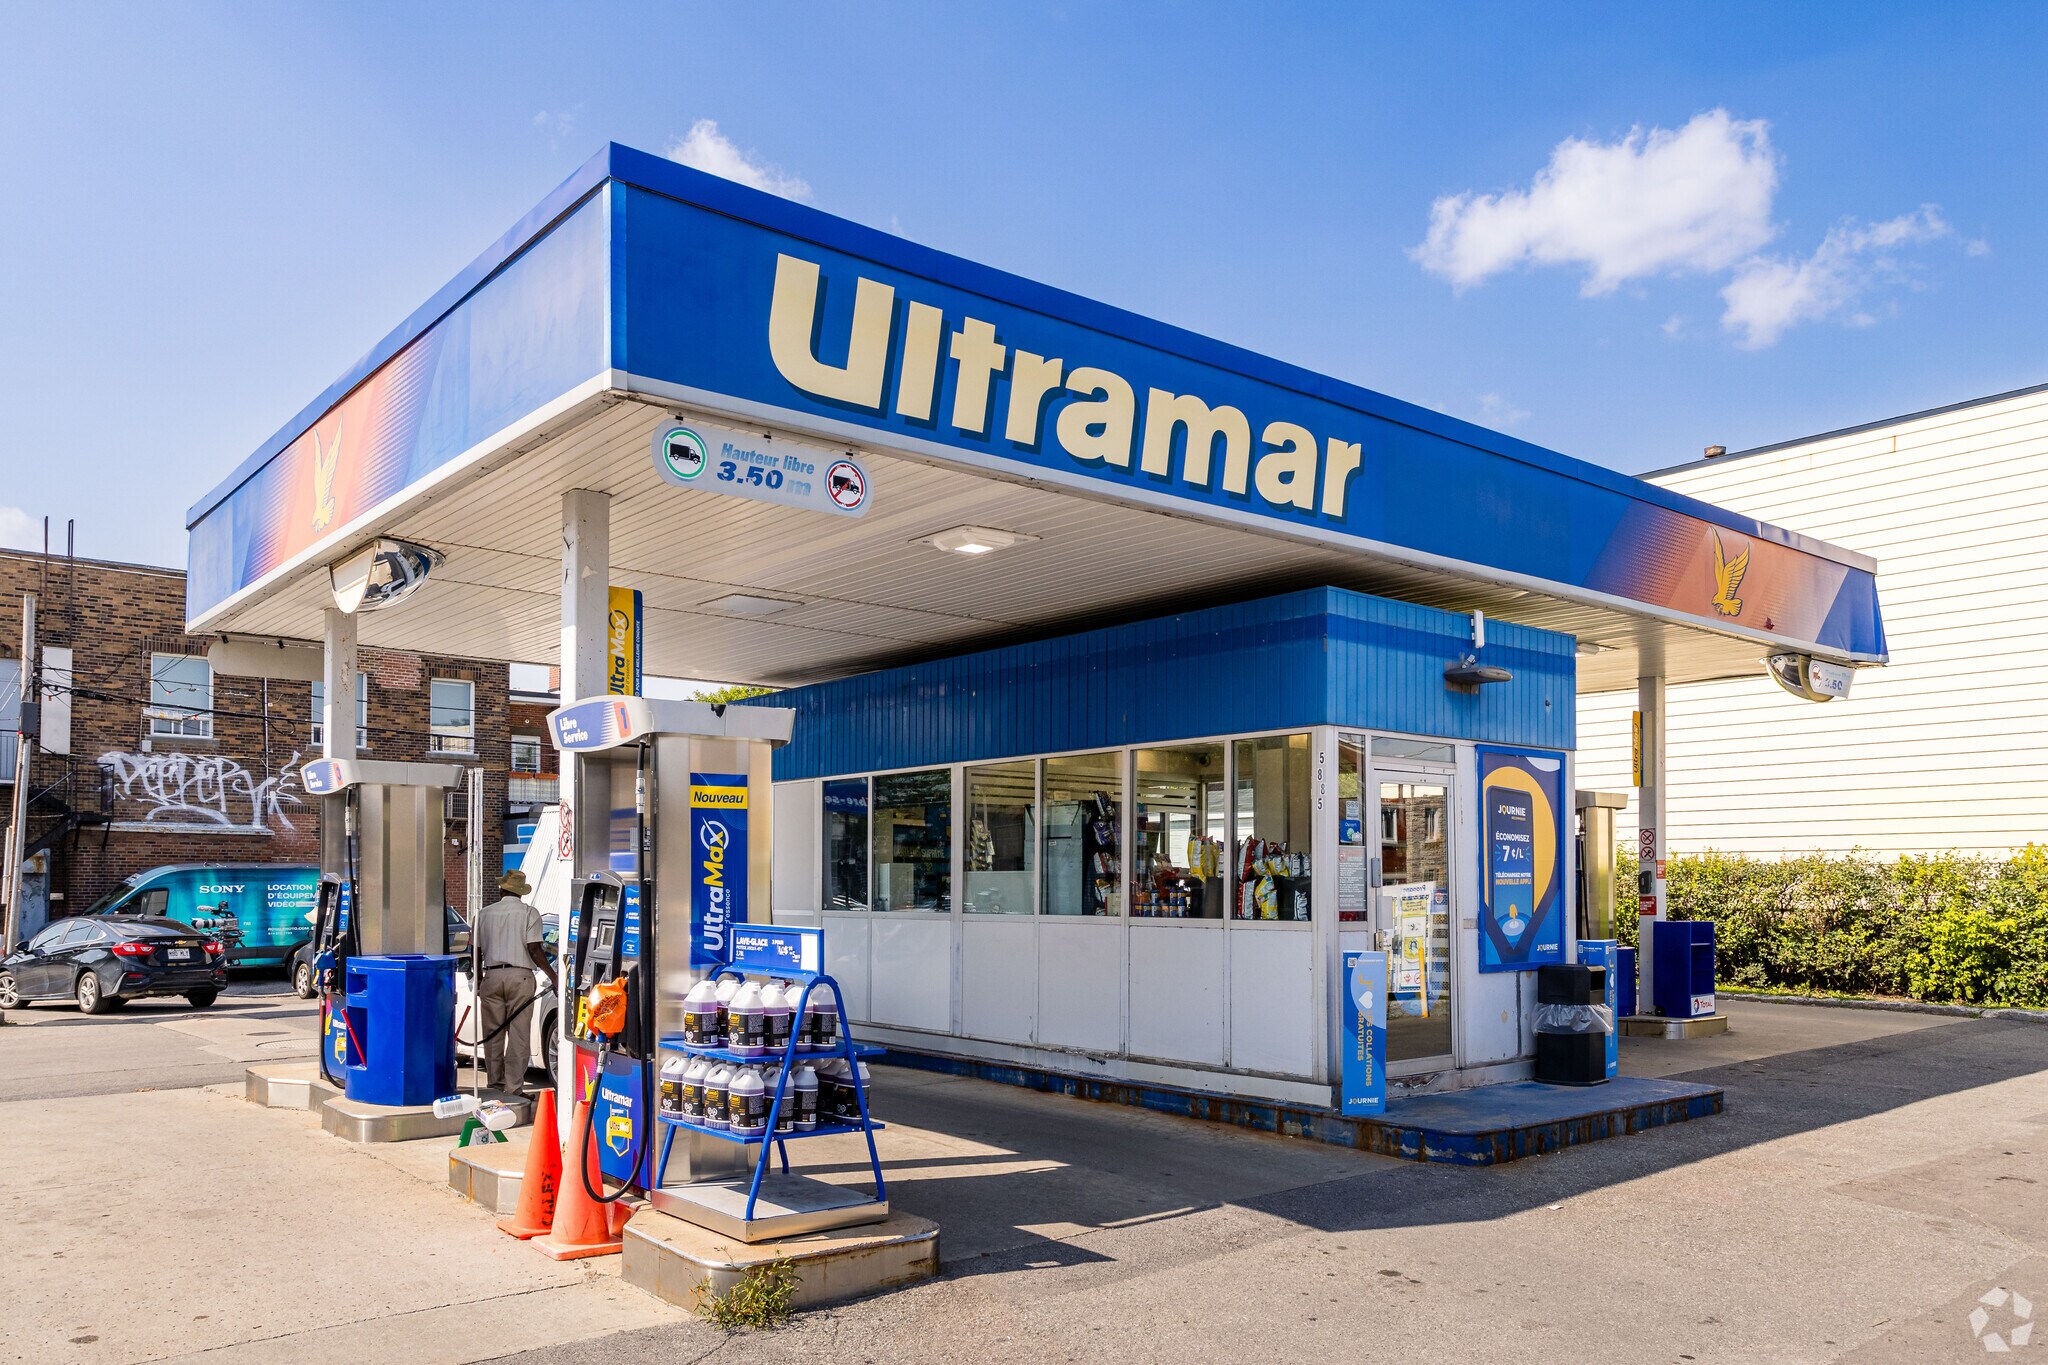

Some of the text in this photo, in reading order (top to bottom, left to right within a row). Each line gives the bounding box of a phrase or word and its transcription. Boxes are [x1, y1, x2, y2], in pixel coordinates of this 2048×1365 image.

[768, 252, 1363, 518] Ultramar
[720, 442, 815, 475] Hauteur libre
[716, 461, 812, 497] 3.50 m
[560, 716, 578, 731] Libre
[563, 729, 588, 744] Service
[693, 791, 744, 804] Nouveau
[1497, 804, 1526, 817] JOURNIE
[1495, 831, 1530, 842] ÉCONOMISEZ
[1502, 845, 1510, 862] 7
[199, 884, 245, 894] SONY
[702, 817, 727, 951] UltraMax
[267, 899, 295, 907] VIDÉO
[736, 936, 769, 947] LAVE-GLACE
[1537, 943, 1559, 952] JOURNIE
[1365, 1028, 1373, 1087] COLLATIONS
[601, 1086, 633, 1108] Ultramar
[1348, 1097, 1379, 1105] JOURNIE
